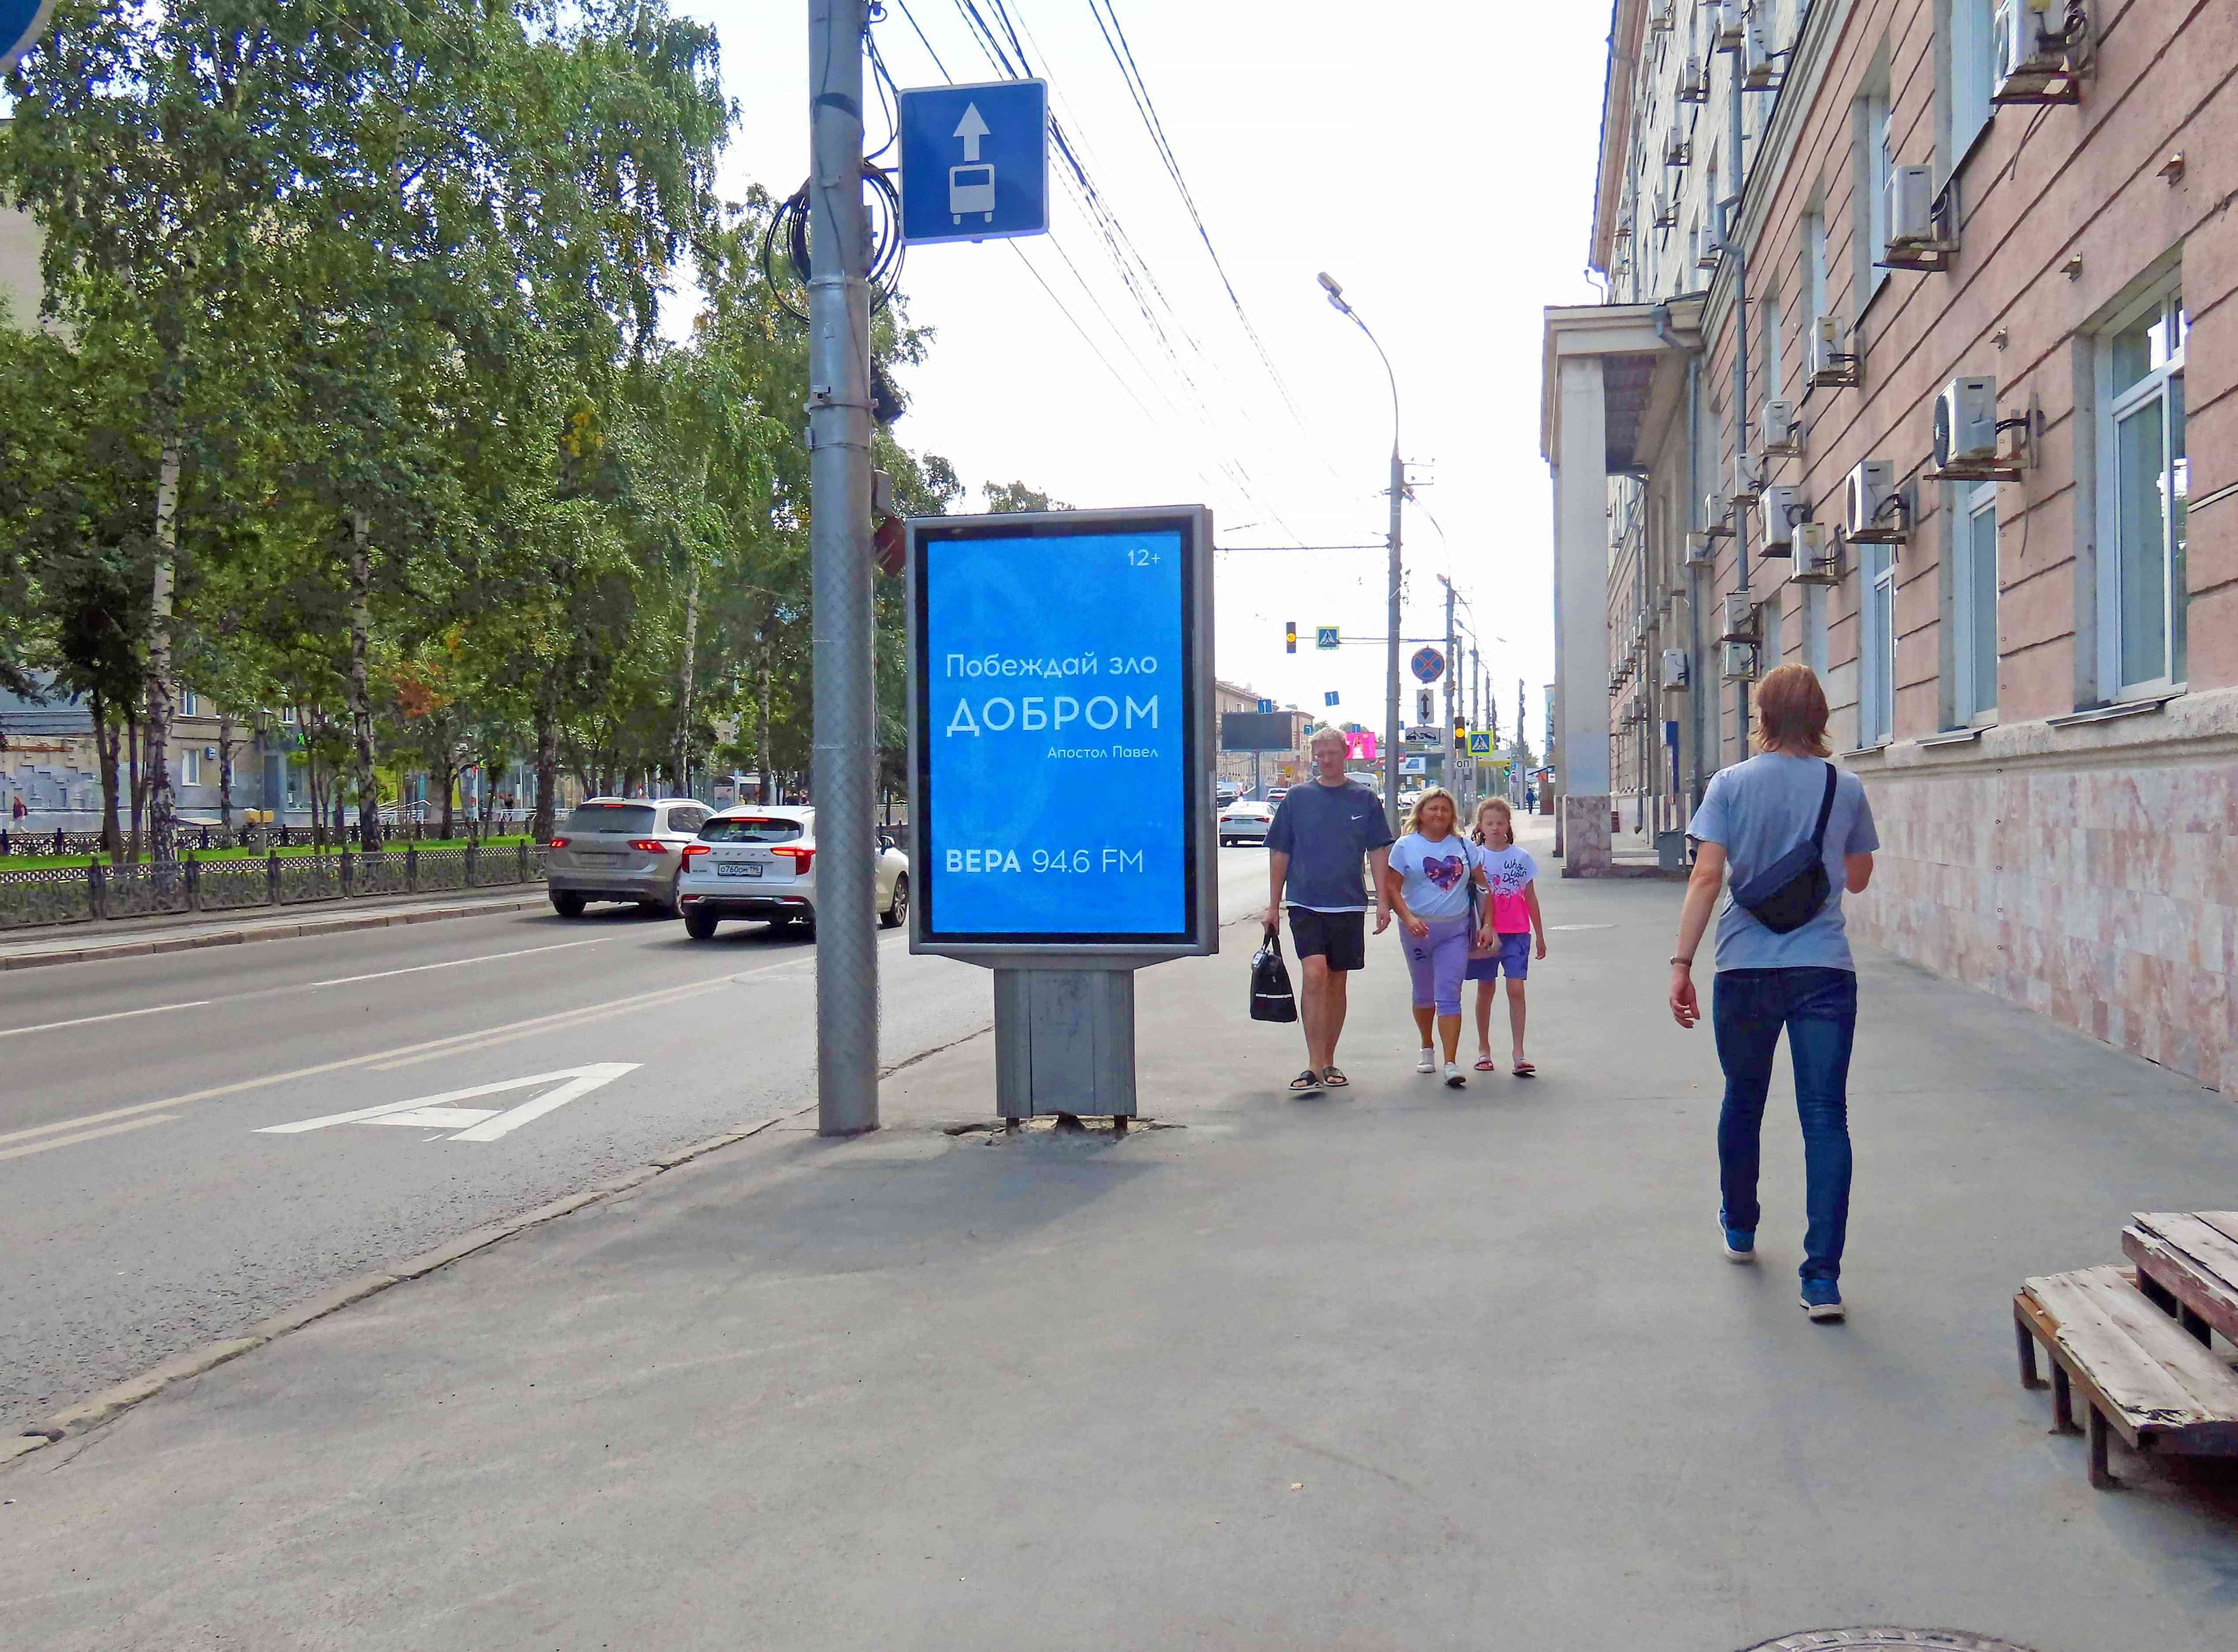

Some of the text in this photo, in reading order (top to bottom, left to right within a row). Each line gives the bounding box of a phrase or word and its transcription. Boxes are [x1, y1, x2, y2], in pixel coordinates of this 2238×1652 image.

[1128, 549, 1160, 566] 12+
[946, 651, 1157, 678] Побеждай зло
[946, 695, 1159, 737] ДОБРОМ
[1048, 745, 1158, 758] Апостол Павел
[946, 849, 1143, 873] ВЕРА 94.6 FM
